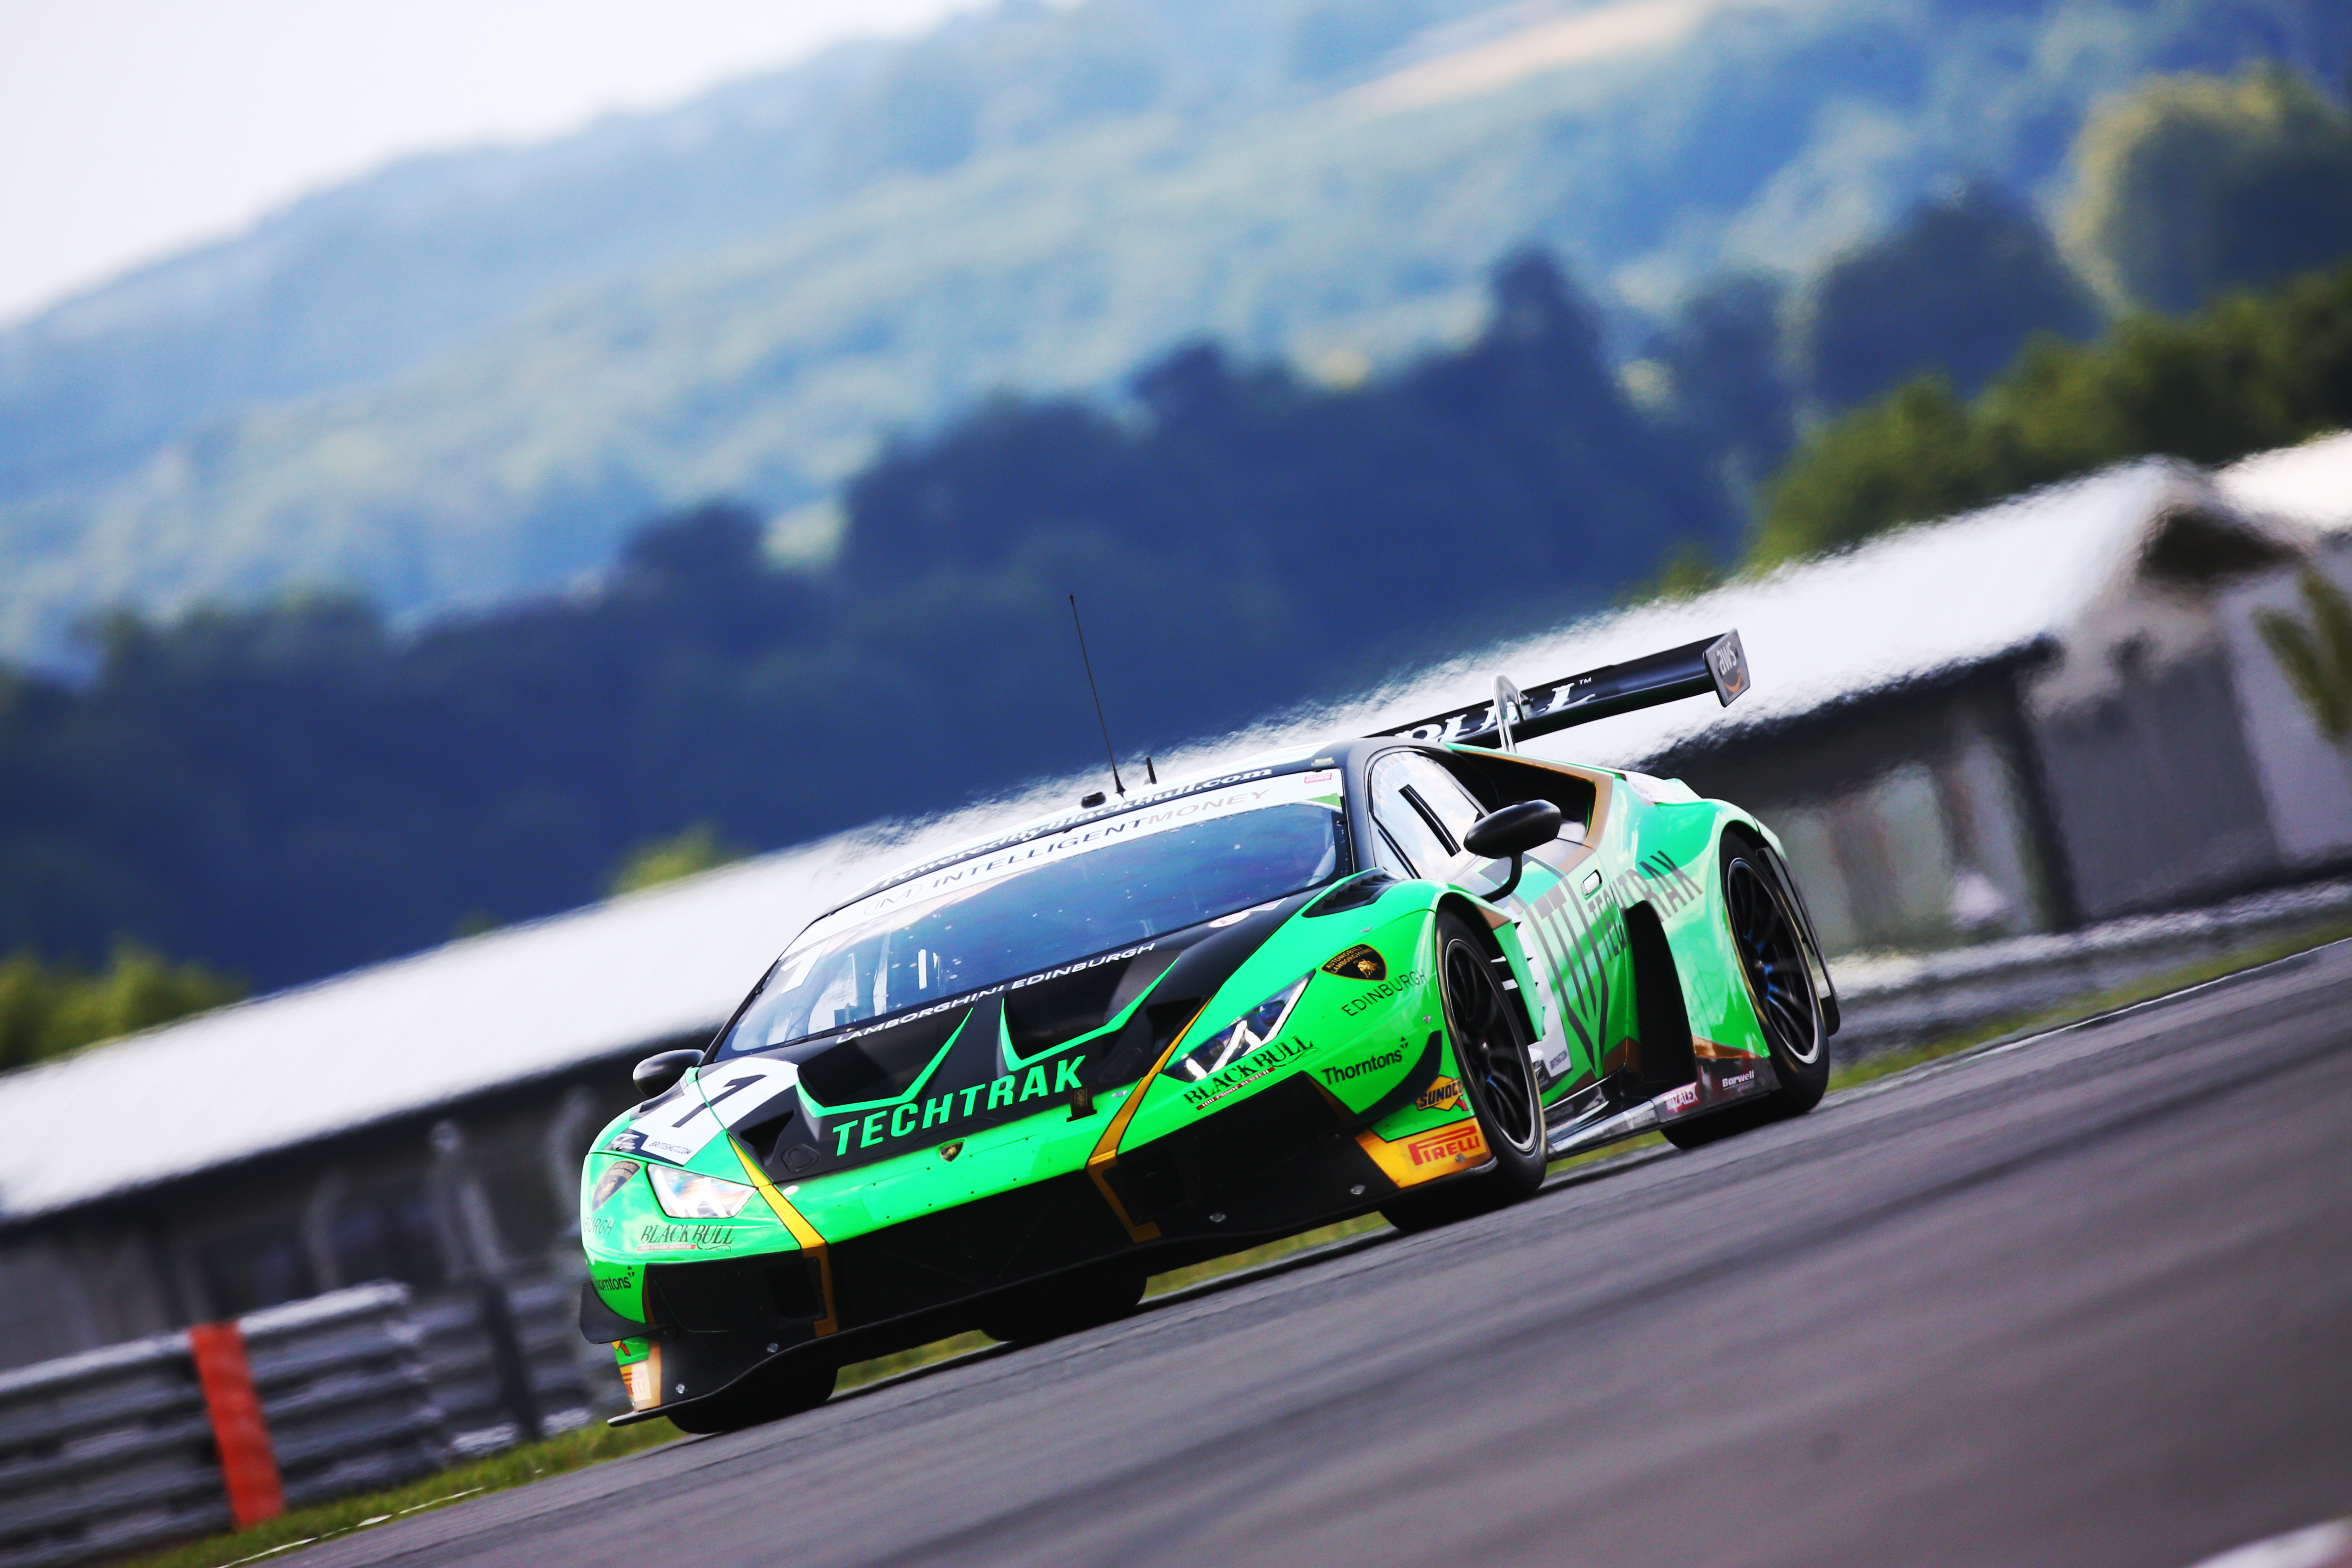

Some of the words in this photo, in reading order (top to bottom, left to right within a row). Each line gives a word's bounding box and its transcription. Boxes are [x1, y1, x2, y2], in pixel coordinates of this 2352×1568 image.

[1716, 641, 1737, 675] aws
[836, 985, 1004, 1044] LAMBORGHINI
[1011, 942, 1155, 990] EDINBURGH
[1341, 969, 1428, 1016] EDINBURGH
[1183, 1061, 1259, 1104] BLACK
[1252, 1035, 1314, 1068] BULL
[1321, 1049, 1402, 1085] Thorntons
[1722, 1069, 1754, 1088] Barwell
[671, 1074, 769, 1128] 1
[832, 1055, 1086, 1156] TECHTRAK
[1407, 1125, 1480, 1166] PIRELLI
[640, 1224, 689, 1244] BLACK
[692, 1224, 735, 1245] BULL
